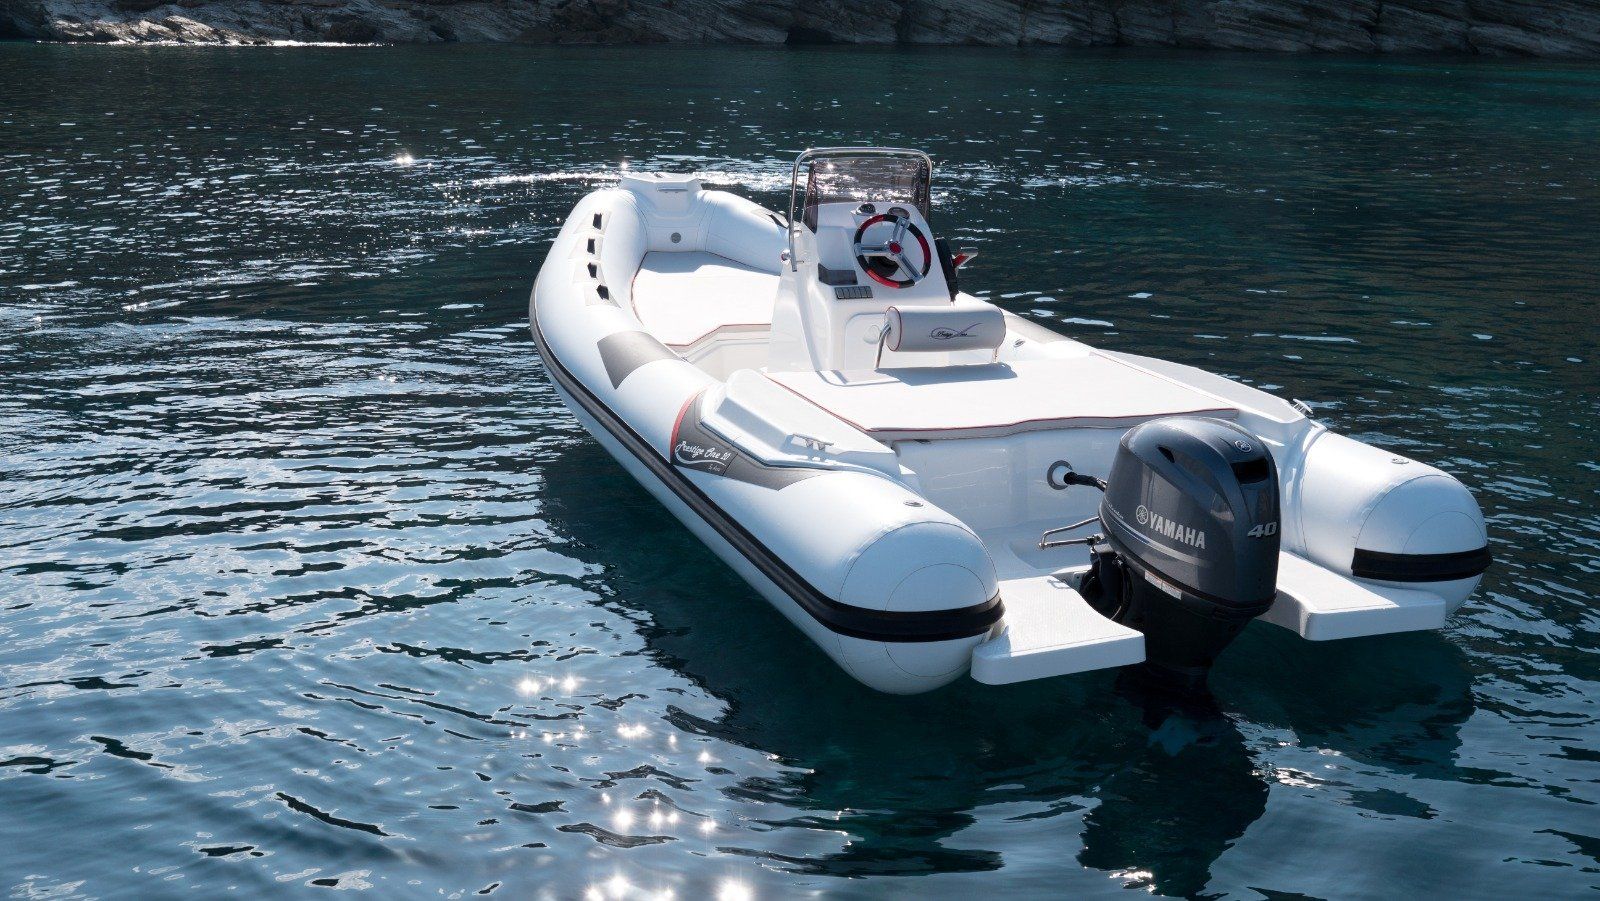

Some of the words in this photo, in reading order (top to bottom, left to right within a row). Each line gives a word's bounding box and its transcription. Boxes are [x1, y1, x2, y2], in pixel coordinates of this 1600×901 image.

[675, 440, 705, 459] Prestige
[704, 447, 721, 459] One
[1149, 511, 1206, 550] YAMAHA
[1247, 521, 1278, 538] 40
